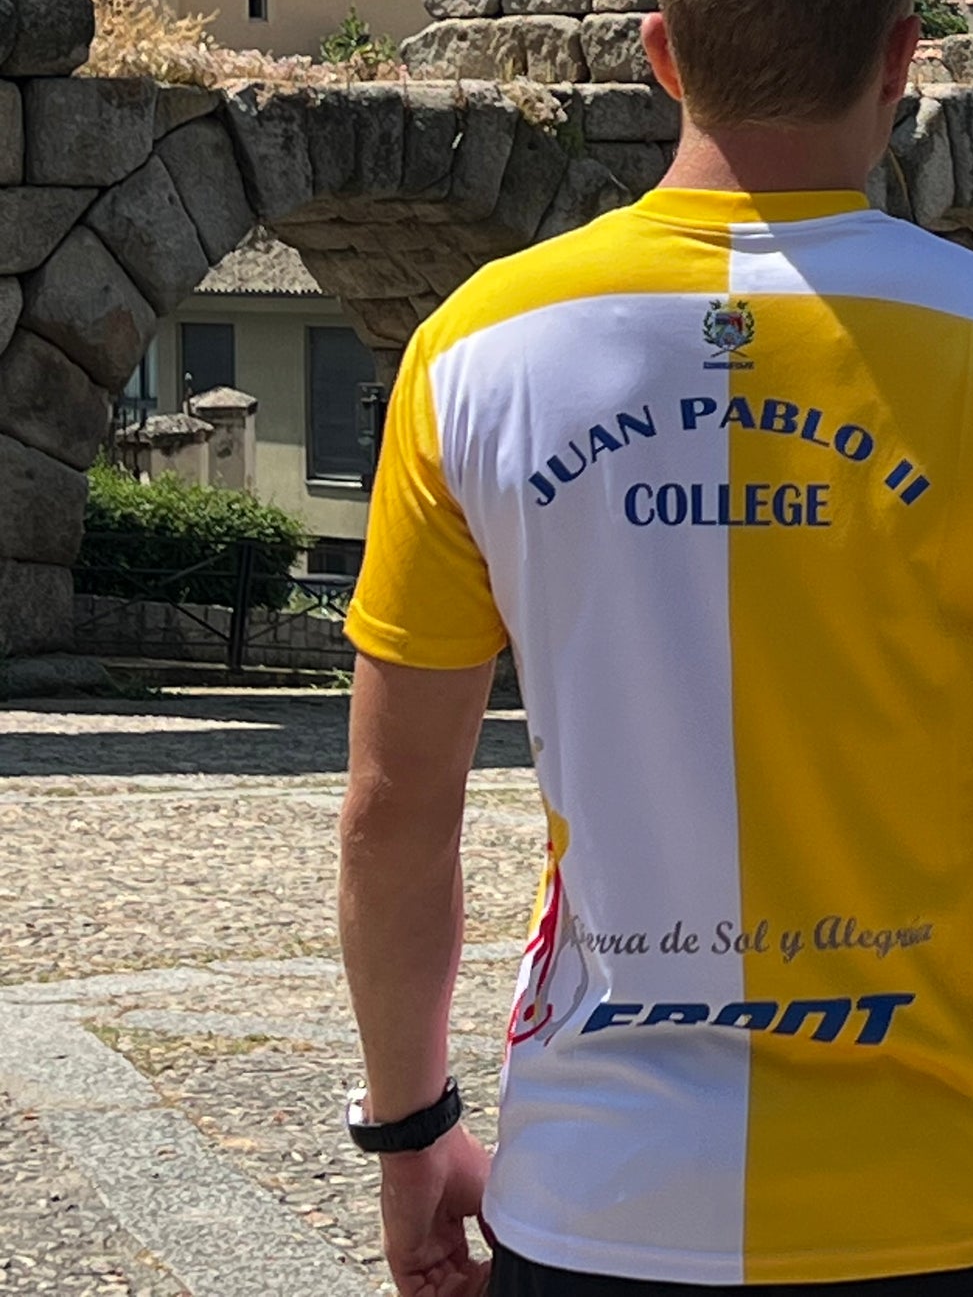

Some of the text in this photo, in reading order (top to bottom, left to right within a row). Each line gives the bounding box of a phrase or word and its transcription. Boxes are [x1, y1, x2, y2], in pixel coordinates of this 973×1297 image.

[527, 395, 931, 507] JUAN PABLO II
[624, 482, 833, 527] COLLEGE
[659, 920, 700, 954] de
[711, 919, 769, 954] Sol
[780, 929, 804, 964] y
